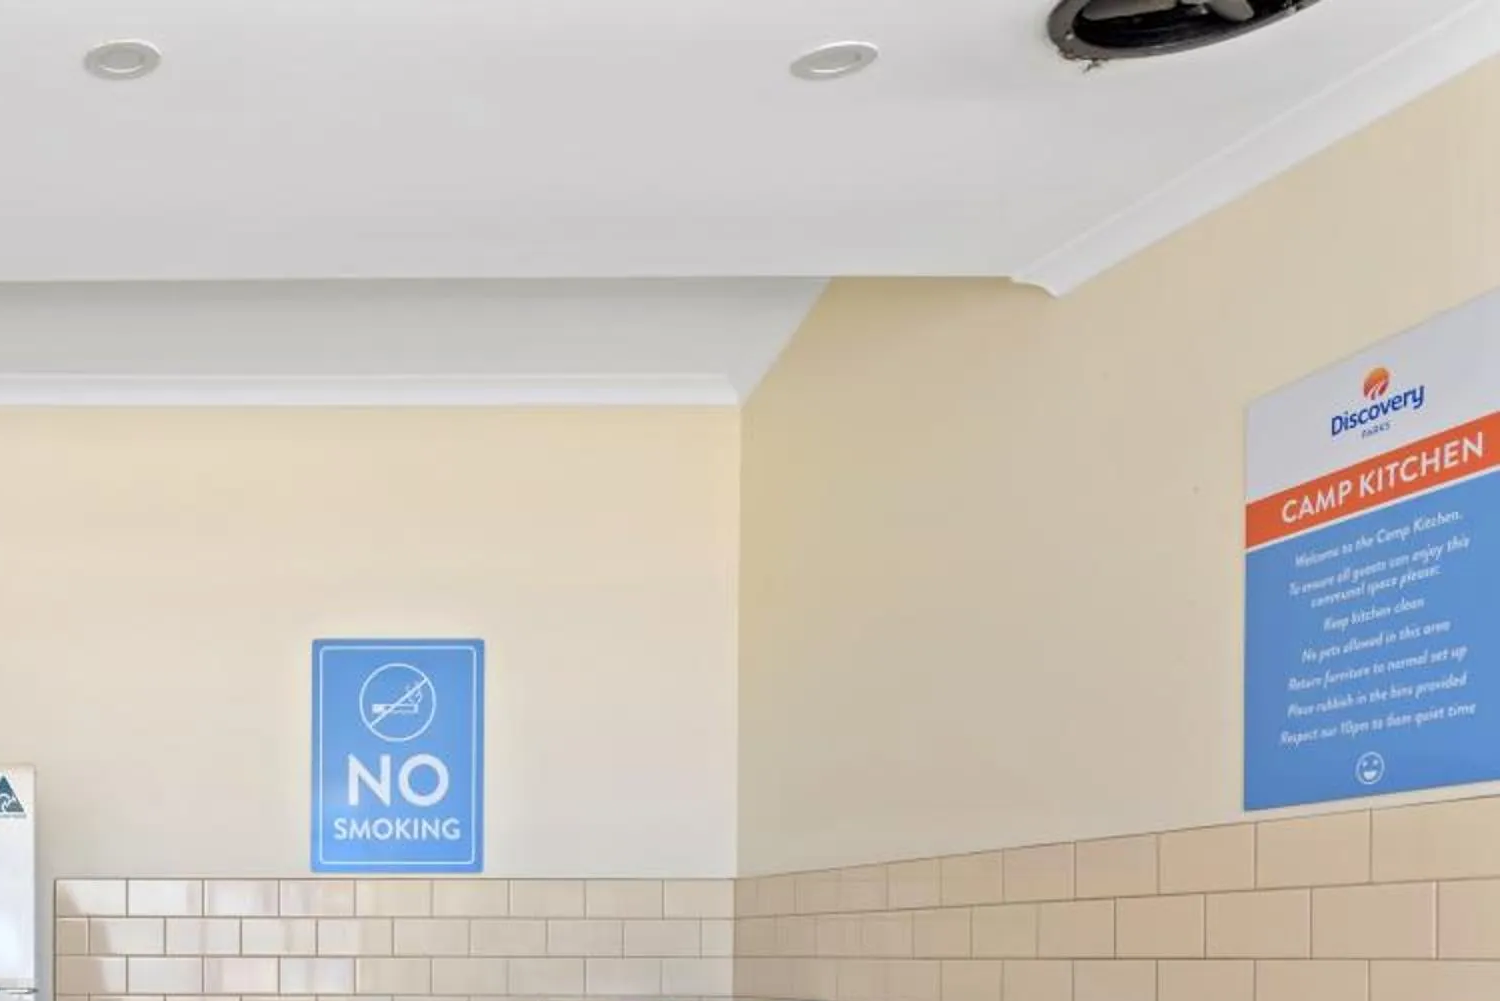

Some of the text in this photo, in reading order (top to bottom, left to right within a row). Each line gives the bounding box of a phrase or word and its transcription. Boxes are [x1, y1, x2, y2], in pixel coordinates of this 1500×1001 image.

[1331, 385, 1425, 436] Discovery
[1361, 422, 1390, 438] PARKS
[1281, 432, 1484, 523] CAMP KITCHEN
[1289, 535, 1470, 595] To ensure all guests can enjoy this
[1295, 545, 1339, 567] Welcome
[1342, 543, 1353, 554] to
[1355, 535, 1374, 551] the
[1376, 528, 1410, 544] Camp
[1311, 584, 1365, 608] communal
[1367, 576, 1397, 595] space
[1324, 597, 1425, 632] Keep kitchen clean
[1302, 621, 1451, 663] No pets allowed in this area
[1288, 645, 1468, 690] Return furniture to normal set up
[1316, 697, 1354, 713] rubbish
[1357, 692, 1367, 704] in
[1370, 689, 1388, 701] the
[1390, 684, 1413, 697] bins
[1415, 672, 1467, 698] provided
[1280, 730, 1318, 746] Respect
[1321, 727, 1337, 737] our
[1340, 720, 1369, 737] 10pm
[1372, 719, 1383, 730] to
[1415, 708, 1444, 727] quiet
[1448, 703, 1476, 717] time
[348, 753, 449, 807] NO
[333, 817, 461, 841] SMOKING
